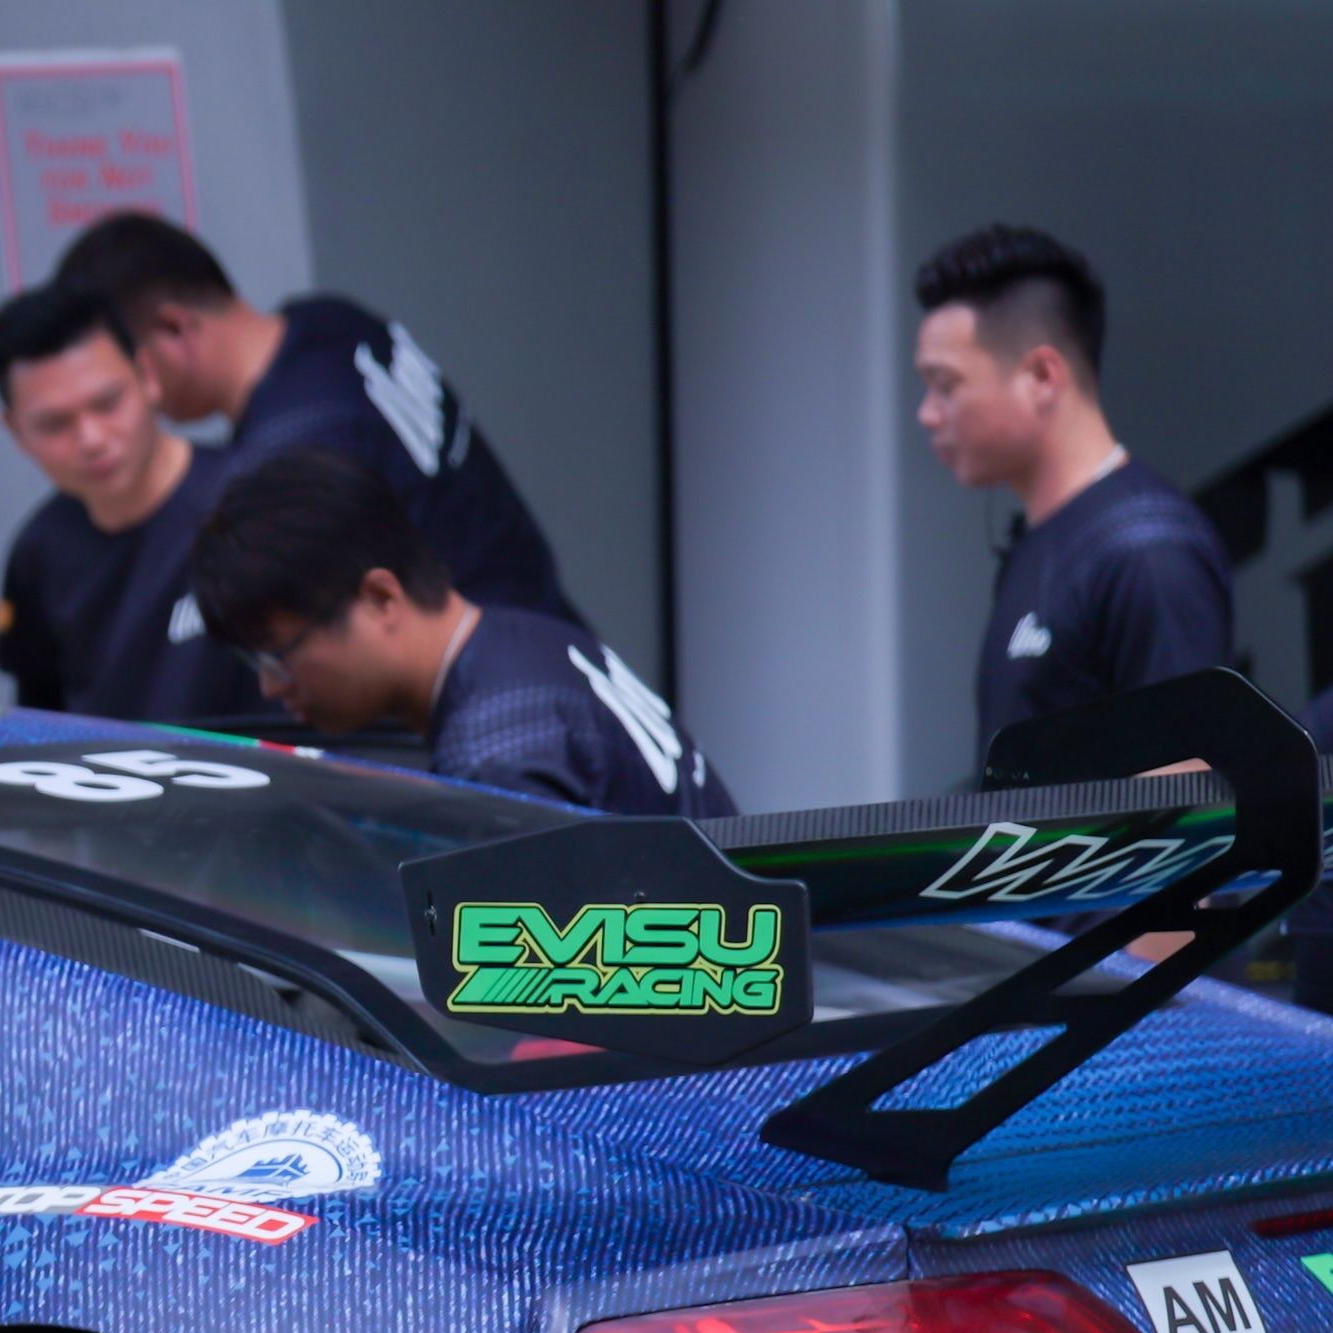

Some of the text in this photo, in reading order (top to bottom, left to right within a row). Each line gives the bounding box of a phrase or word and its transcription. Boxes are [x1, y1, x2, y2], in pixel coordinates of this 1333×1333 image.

[456, 905, 779, 967] EVISU
[545, 967, 780, 1010] RACING
[83, 1188, 306, 1241] SPEED
